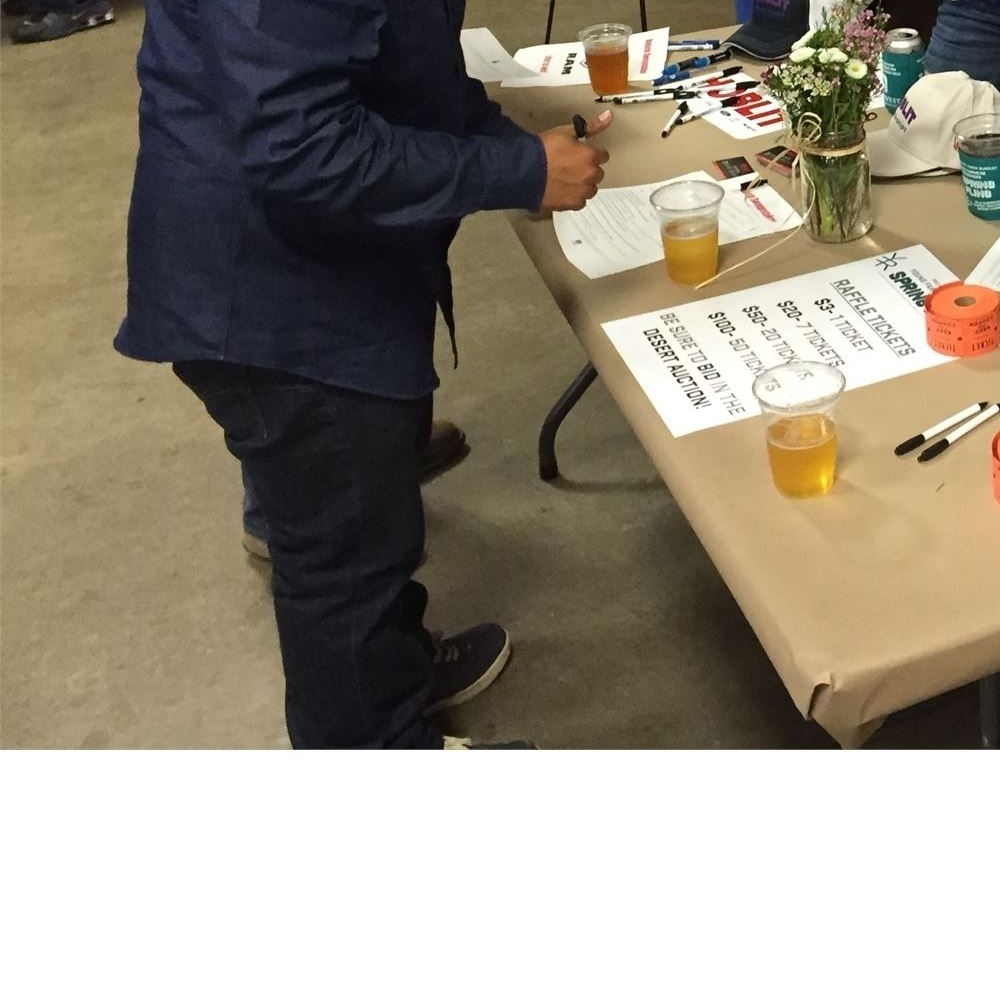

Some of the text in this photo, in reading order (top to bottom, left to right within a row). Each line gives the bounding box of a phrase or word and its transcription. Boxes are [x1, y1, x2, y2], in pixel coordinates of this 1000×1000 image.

[561, 52, 578, 75] RAM
[813, 297, 836, 315] $3-
[835, 319, 874, 352] TICKET
[833, 278, 917, 356] RAFFLE TICKETS
[889, 271, 926, 308] SPRING
[643, 328, 713, 410] DESERT AUCTION!
[660, 312, 747, 416] BE SURE TO BID IN THE
[707, 311, 781, 392] $100- 50 TICKTS
[741, 305, 814, 381] $50- 20 TICKTS
[776, 300, 846, 369] $20- 7 TICKETS
